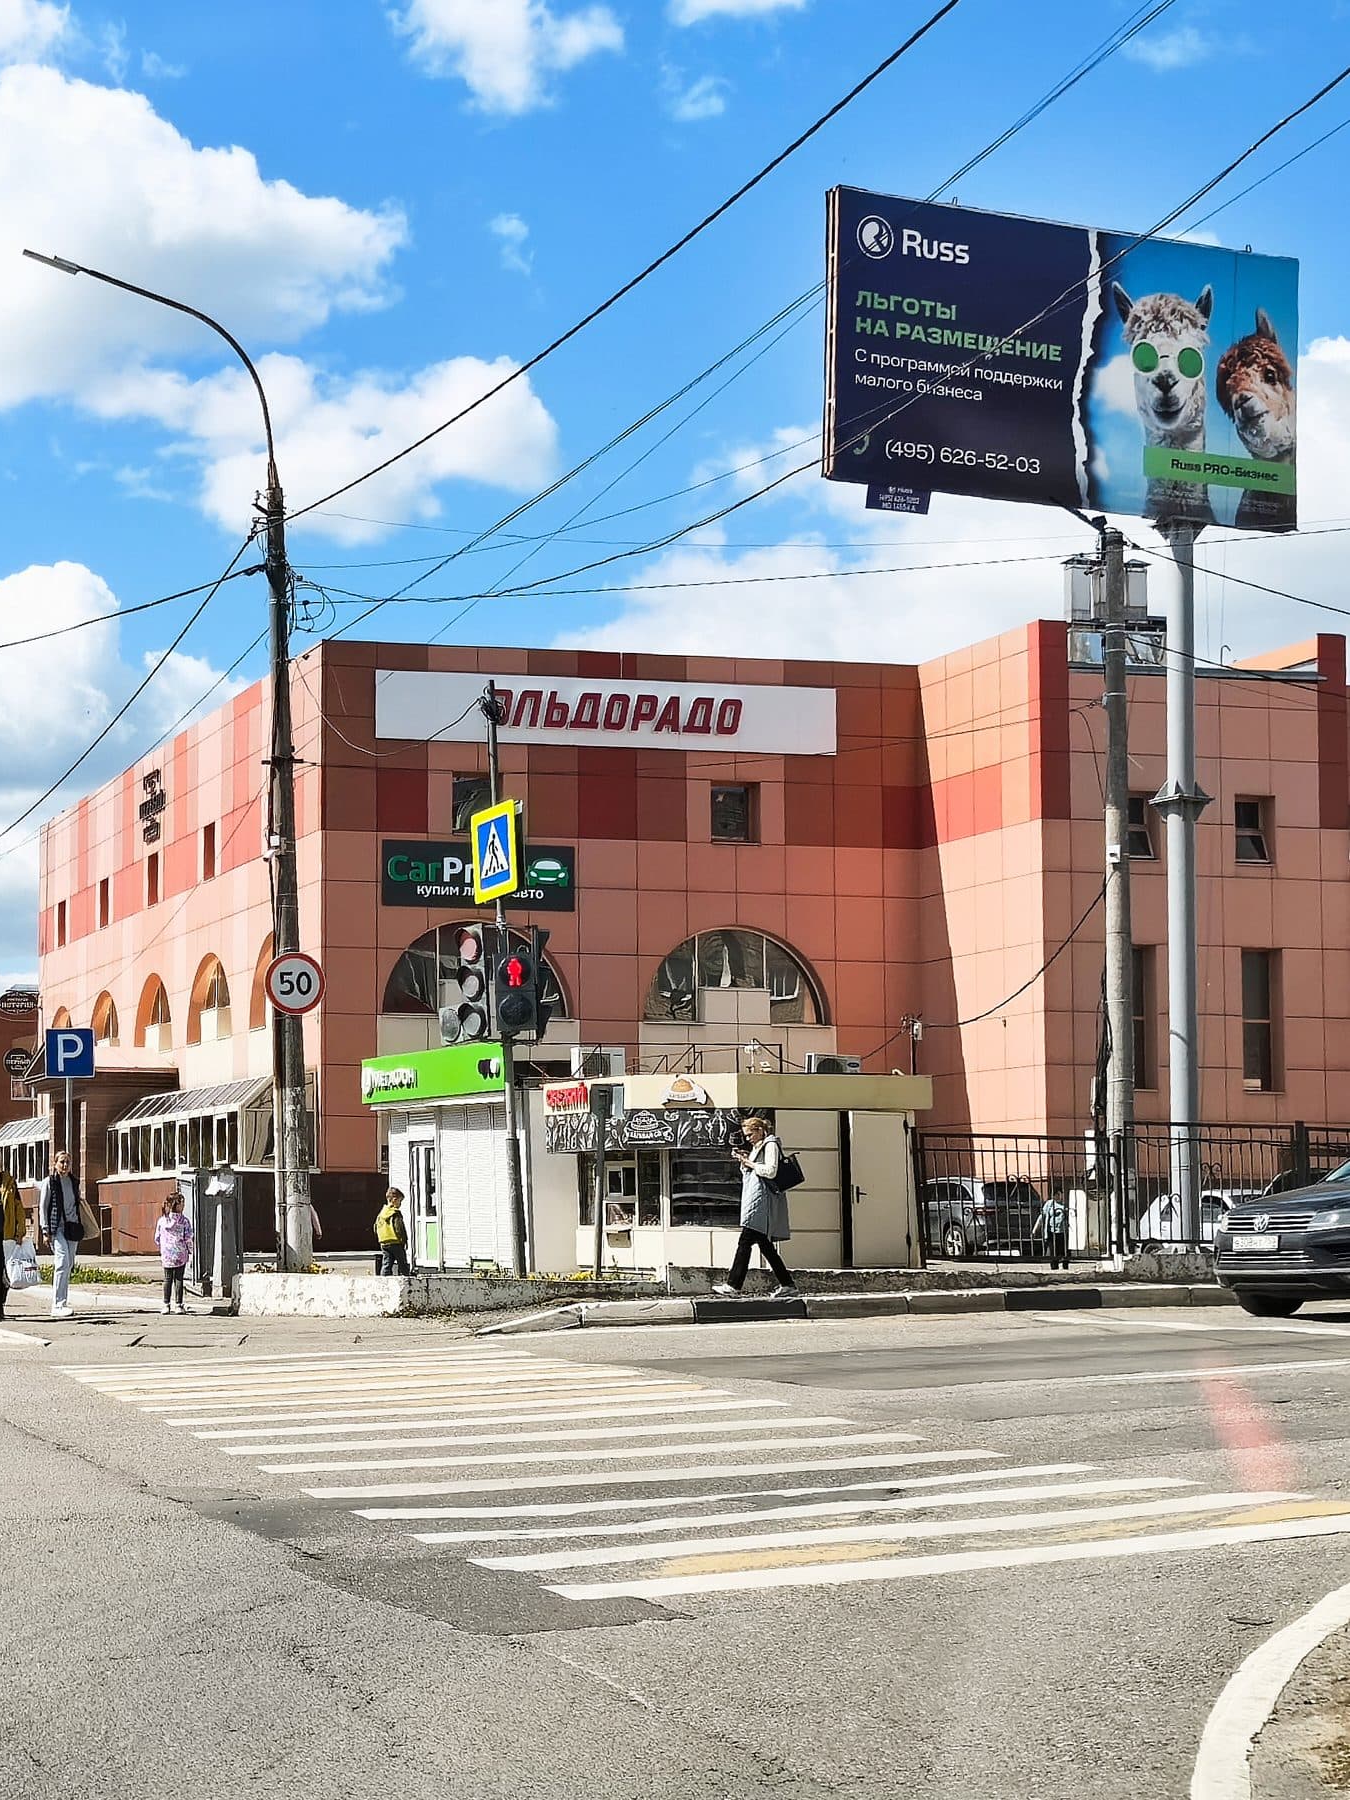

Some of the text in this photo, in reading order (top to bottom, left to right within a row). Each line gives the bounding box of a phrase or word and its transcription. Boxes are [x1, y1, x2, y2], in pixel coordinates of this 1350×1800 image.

[902, 228, 970, 265] Russ
[856, 290, 957, 321] ЛЬГОТЫ
[856, 316, 1062, 362] НА РАЗМЕЩЕНИЕ
[854, 348, 1063, 391] С программой поддержки
[855, 373, 983, 401] малого бизнеса
[885, 438, 1041, 474] (495) 626-52-03
[1170, 458, 1201, 473] Russ
[387, 855, 474, 884] CarPr
[416, 884, 460, 898] купим
[279, 971, 313, 996] 50
[57, 1033, 84, 1072] P
